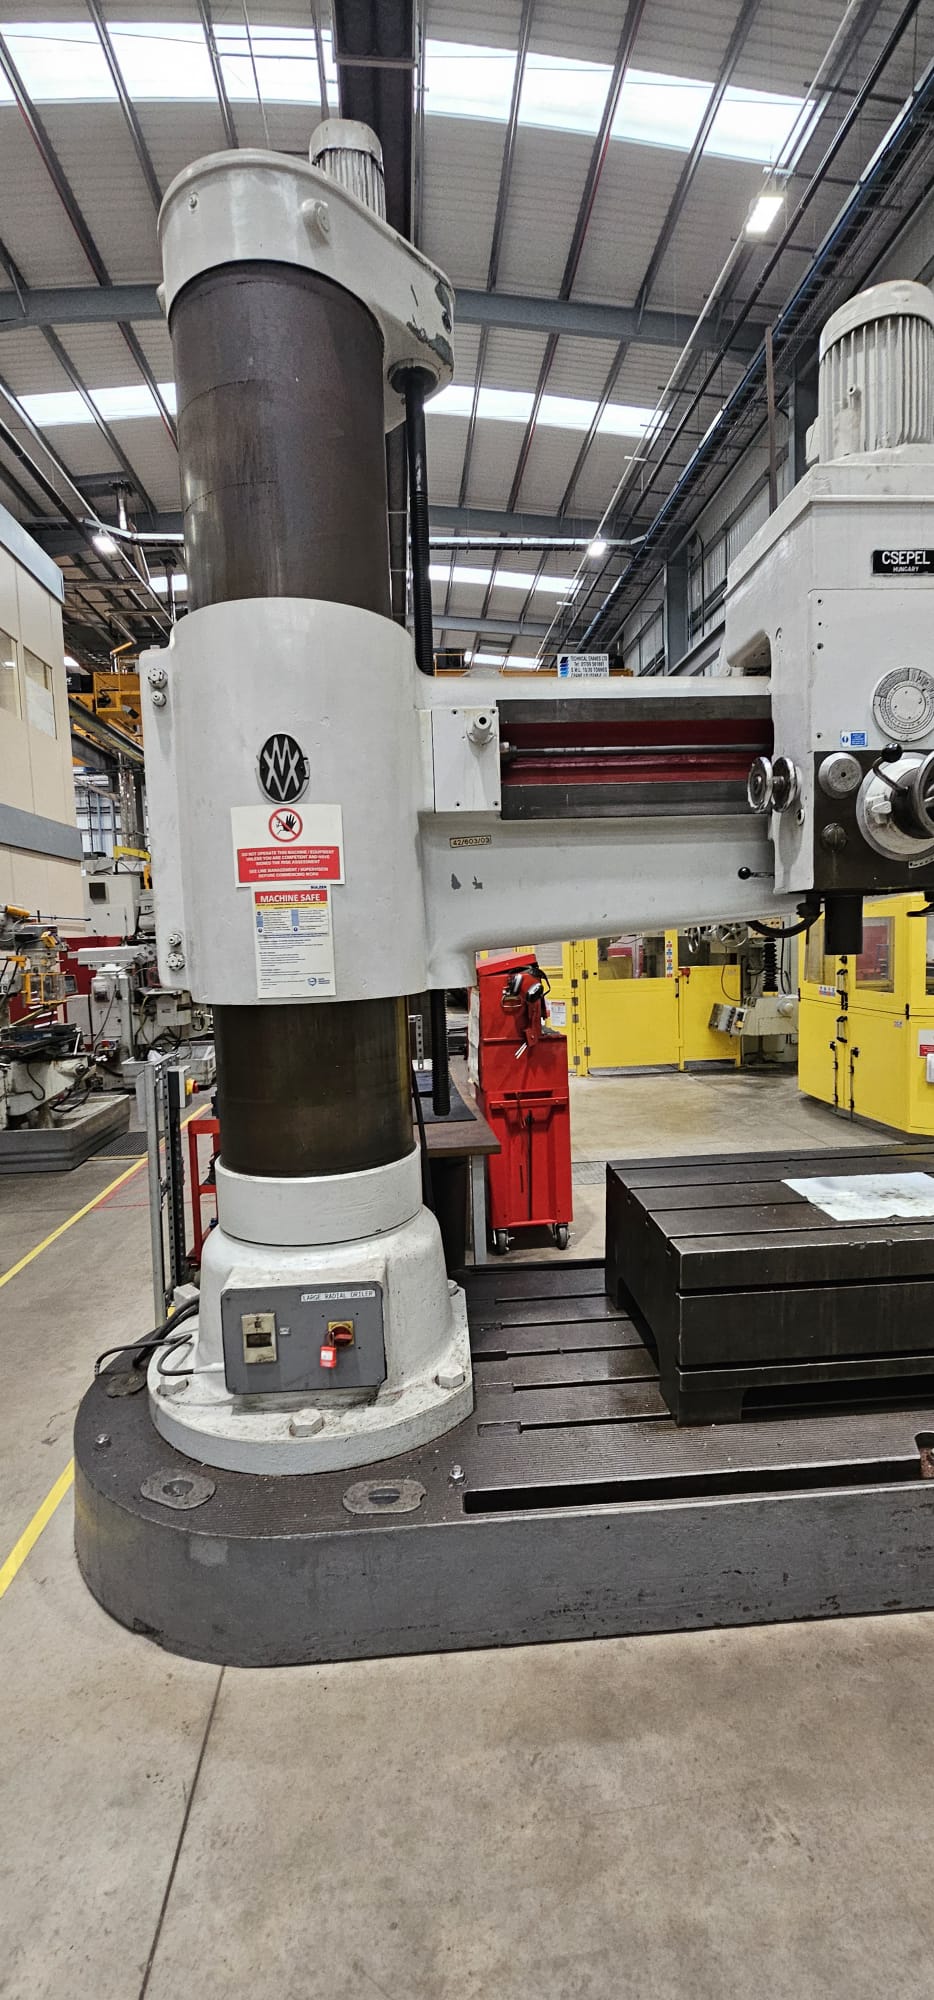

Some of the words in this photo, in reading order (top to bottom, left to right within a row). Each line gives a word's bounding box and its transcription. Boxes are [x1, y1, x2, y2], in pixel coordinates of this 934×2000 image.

[881, 550, 931, 565] CSEPEL
[260, 894, 299, 903] MACHINE
[300, 893, 321, 901] SAFE
